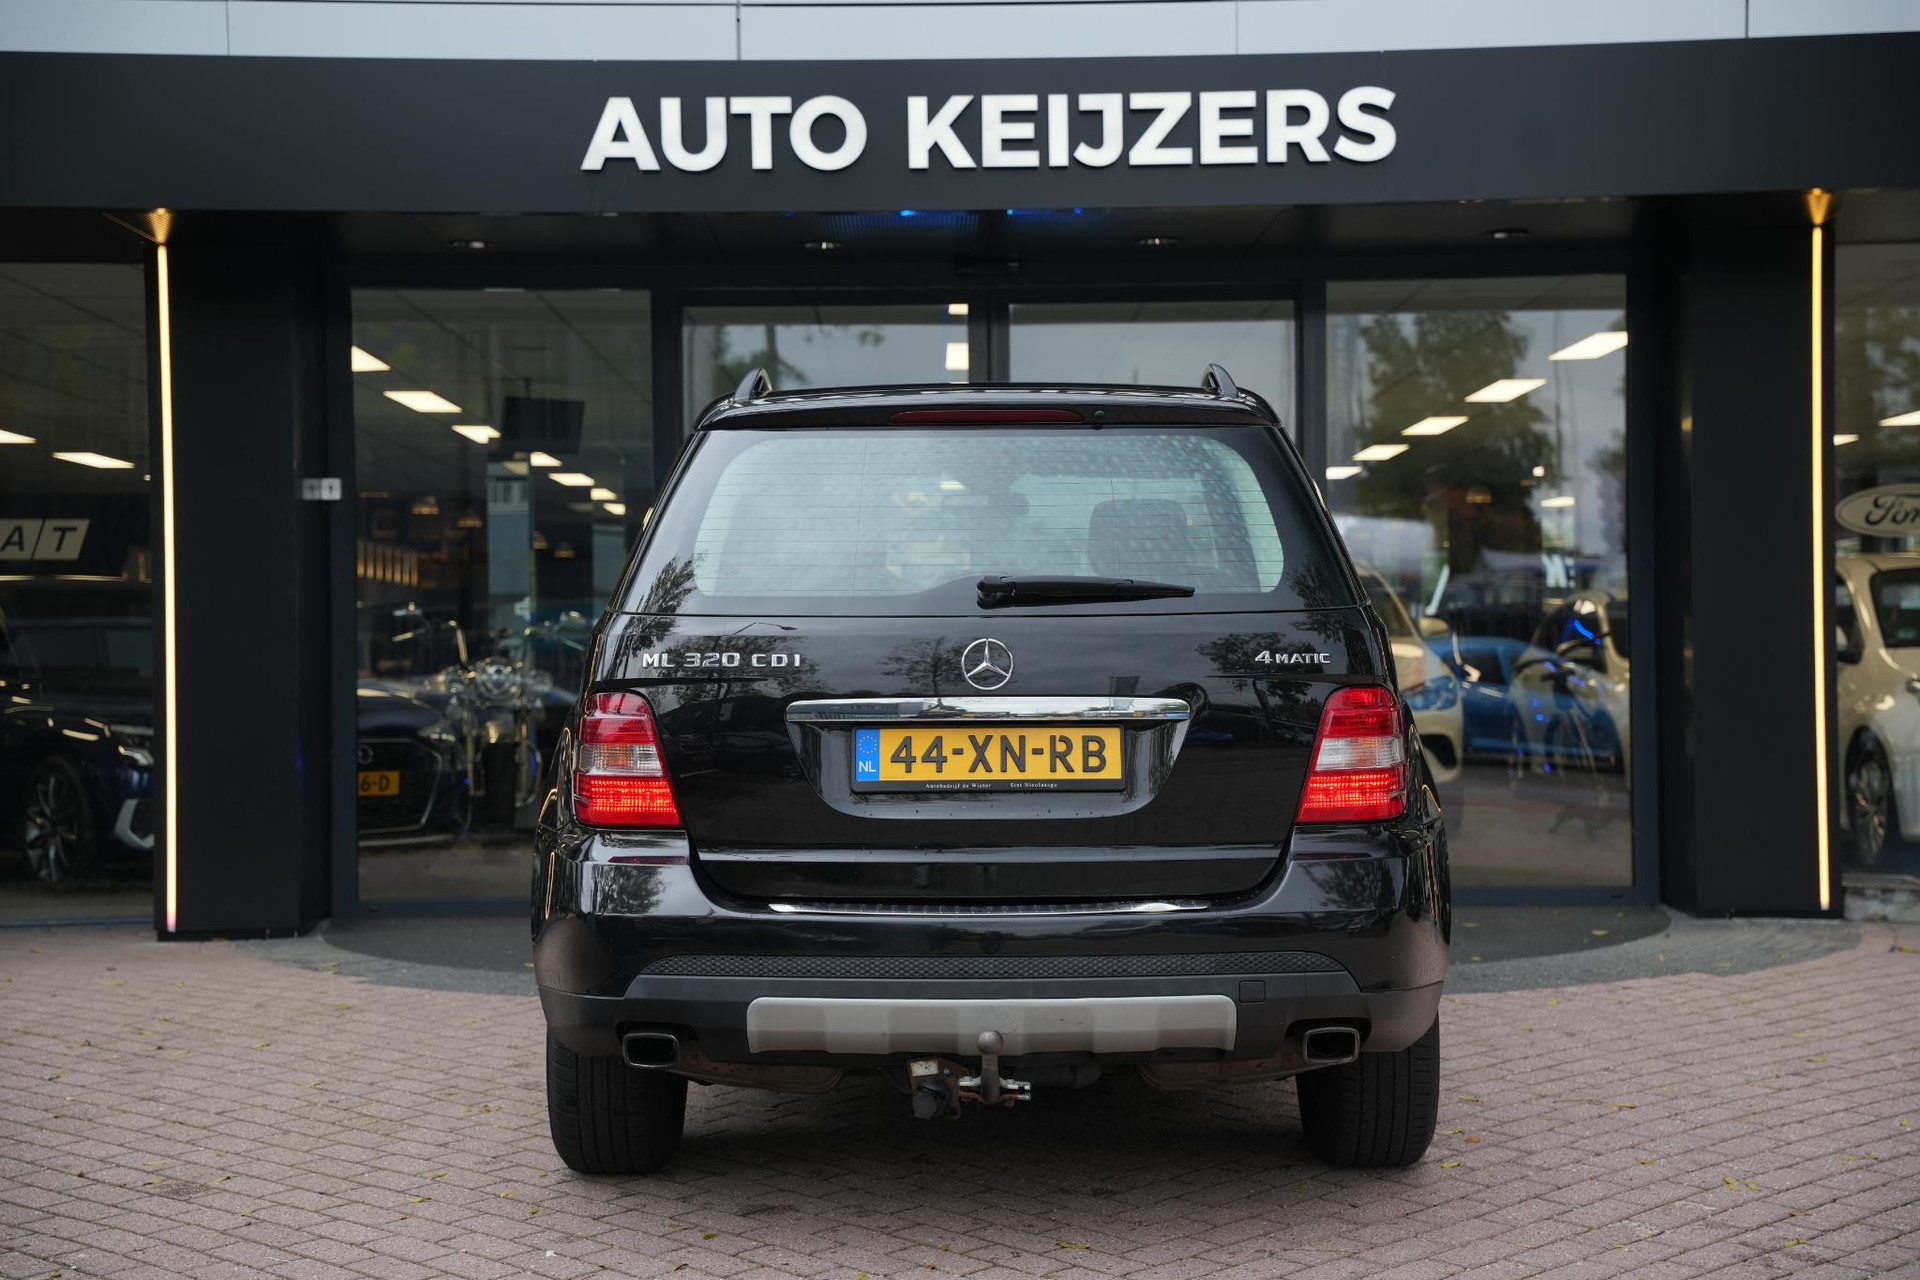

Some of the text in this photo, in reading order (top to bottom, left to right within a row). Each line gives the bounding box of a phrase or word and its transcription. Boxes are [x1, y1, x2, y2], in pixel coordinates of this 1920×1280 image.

[580, 85, 1398, 172] AUTO KEIJZERS
[642, 652, 801, 668] ML 320 CDI
[858, 734, 1107, 774] NL 44-XN-RB
